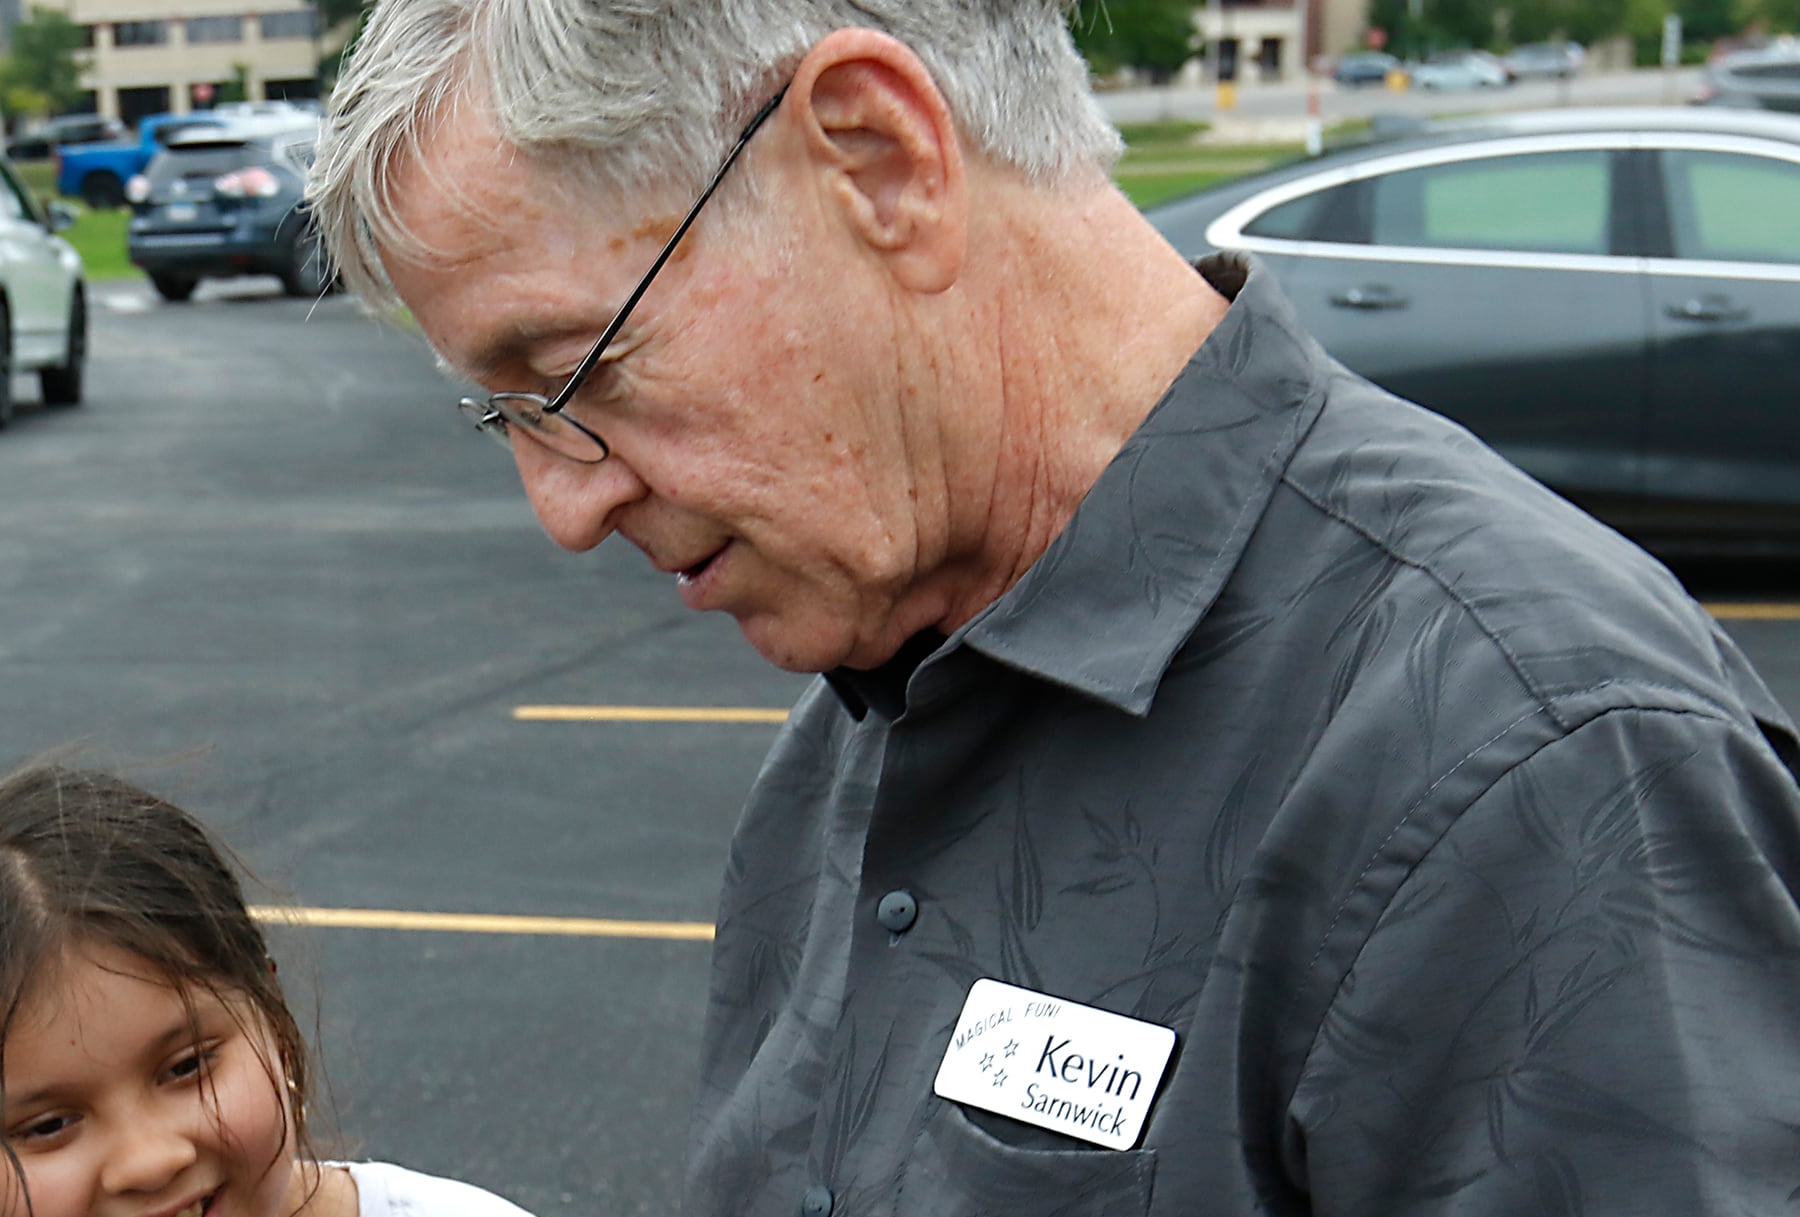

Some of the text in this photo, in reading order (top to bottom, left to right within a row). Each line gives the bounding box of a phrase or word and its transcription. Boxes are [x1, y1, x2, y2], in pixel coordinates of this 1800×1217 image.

[955, 1007, 1013, 1051] MAGICAL
[1035, 1035, 1142, 1101] Kevin
[1021, 1083, 1127, 1136] Sarnwick
